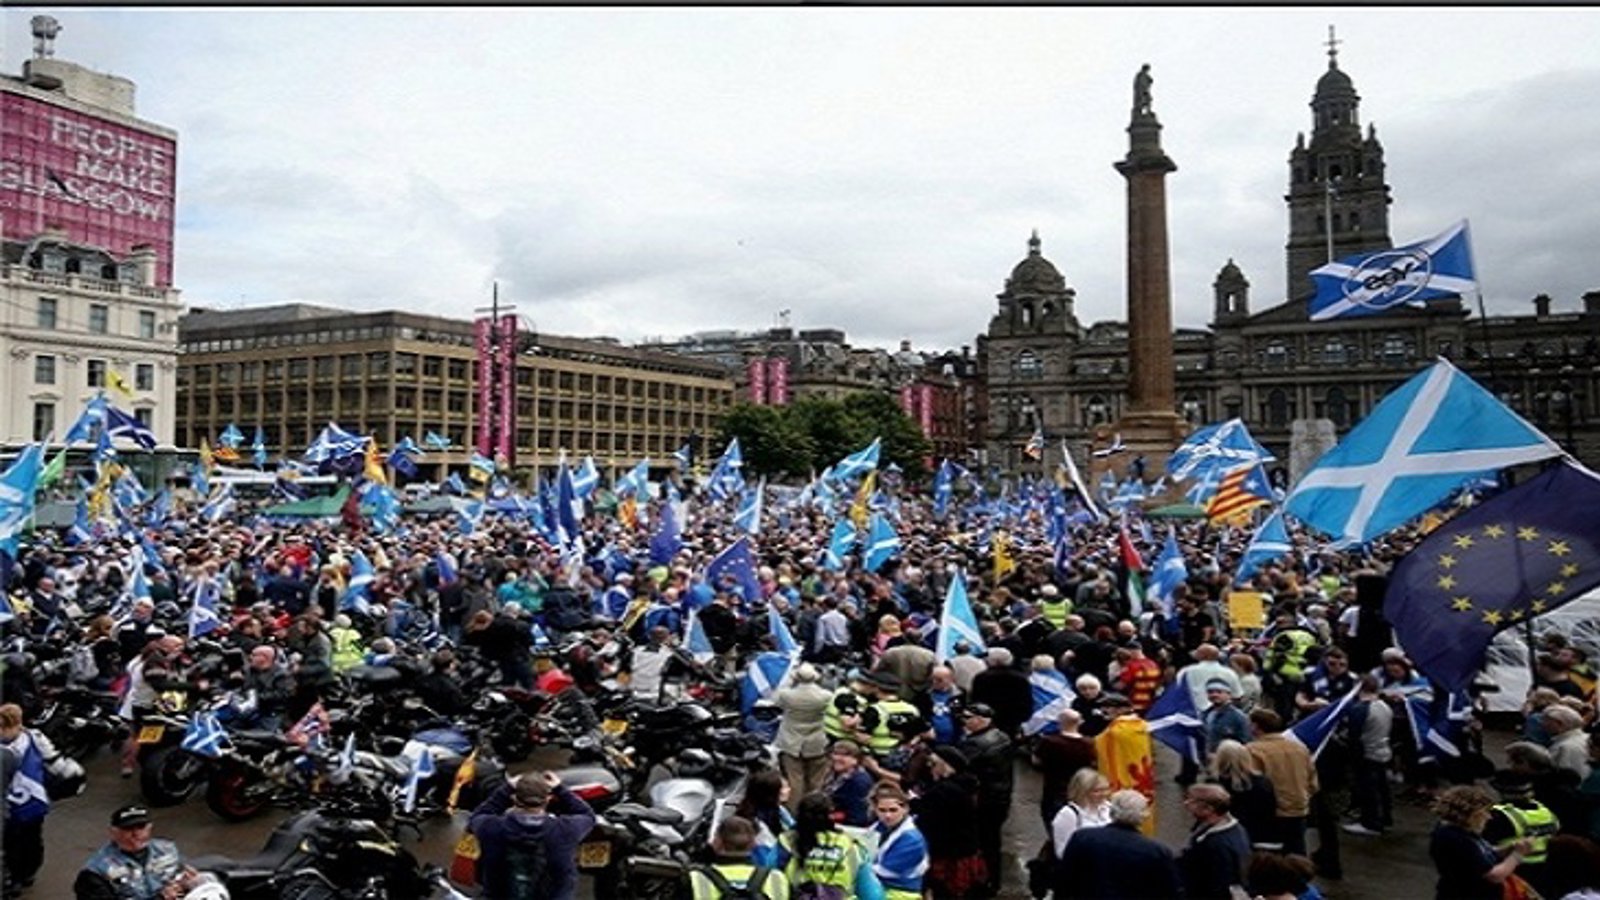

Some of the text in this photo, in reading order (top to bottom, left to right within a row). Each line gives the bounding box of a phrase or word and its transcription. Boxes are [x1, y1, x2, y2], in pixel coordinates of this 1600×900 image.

[51, 116, 168, 171] PEOPLE
[0, 162, 161, 221] GLASGOW
[77, 153, 169, 195] MAKE
